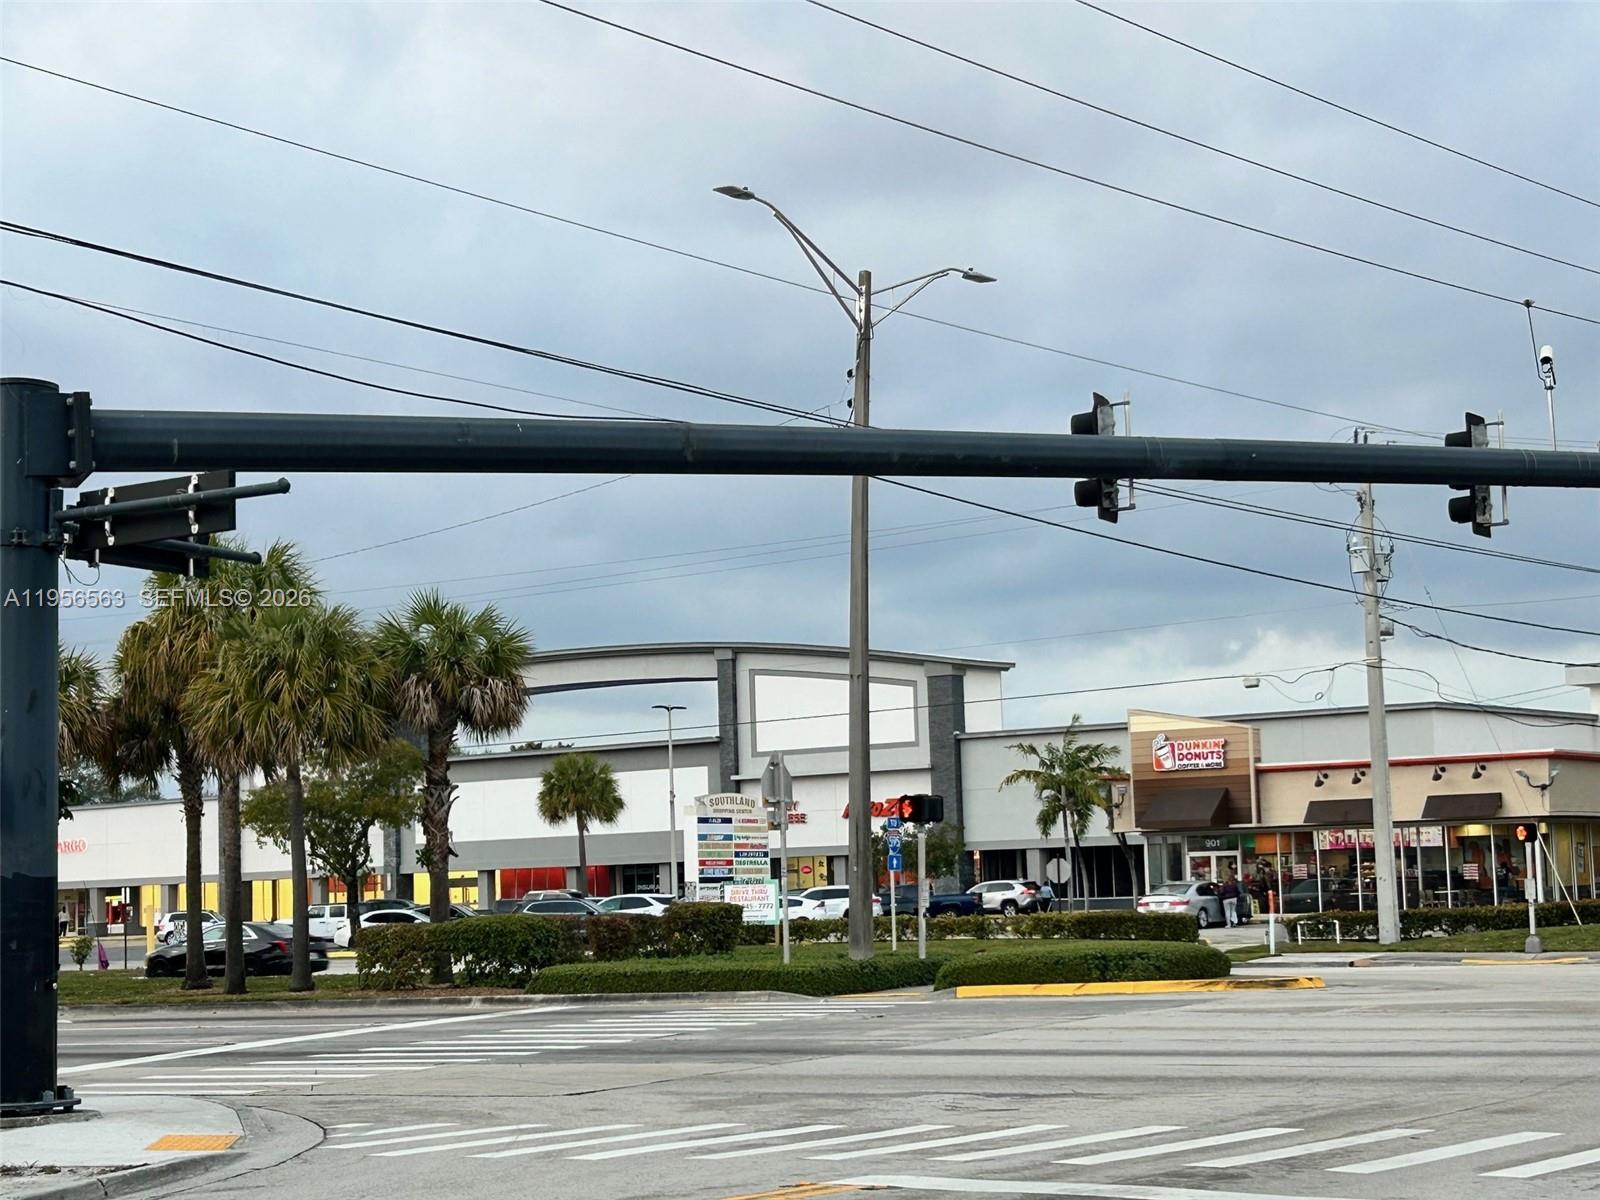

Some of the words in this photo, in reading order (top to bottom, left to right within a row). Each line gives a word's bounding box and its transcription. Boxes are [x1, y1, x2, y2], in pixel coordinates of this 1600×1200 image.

[1177, 740, 1223, 751] DUNKIN'
[1177, 751, 1222, 761] DONUTS
[708, 796, 756, 809] SOUTHLAND
[1205, 839, 1220, 848] 901
[729, 895, 769, 903] RESTAURANT
